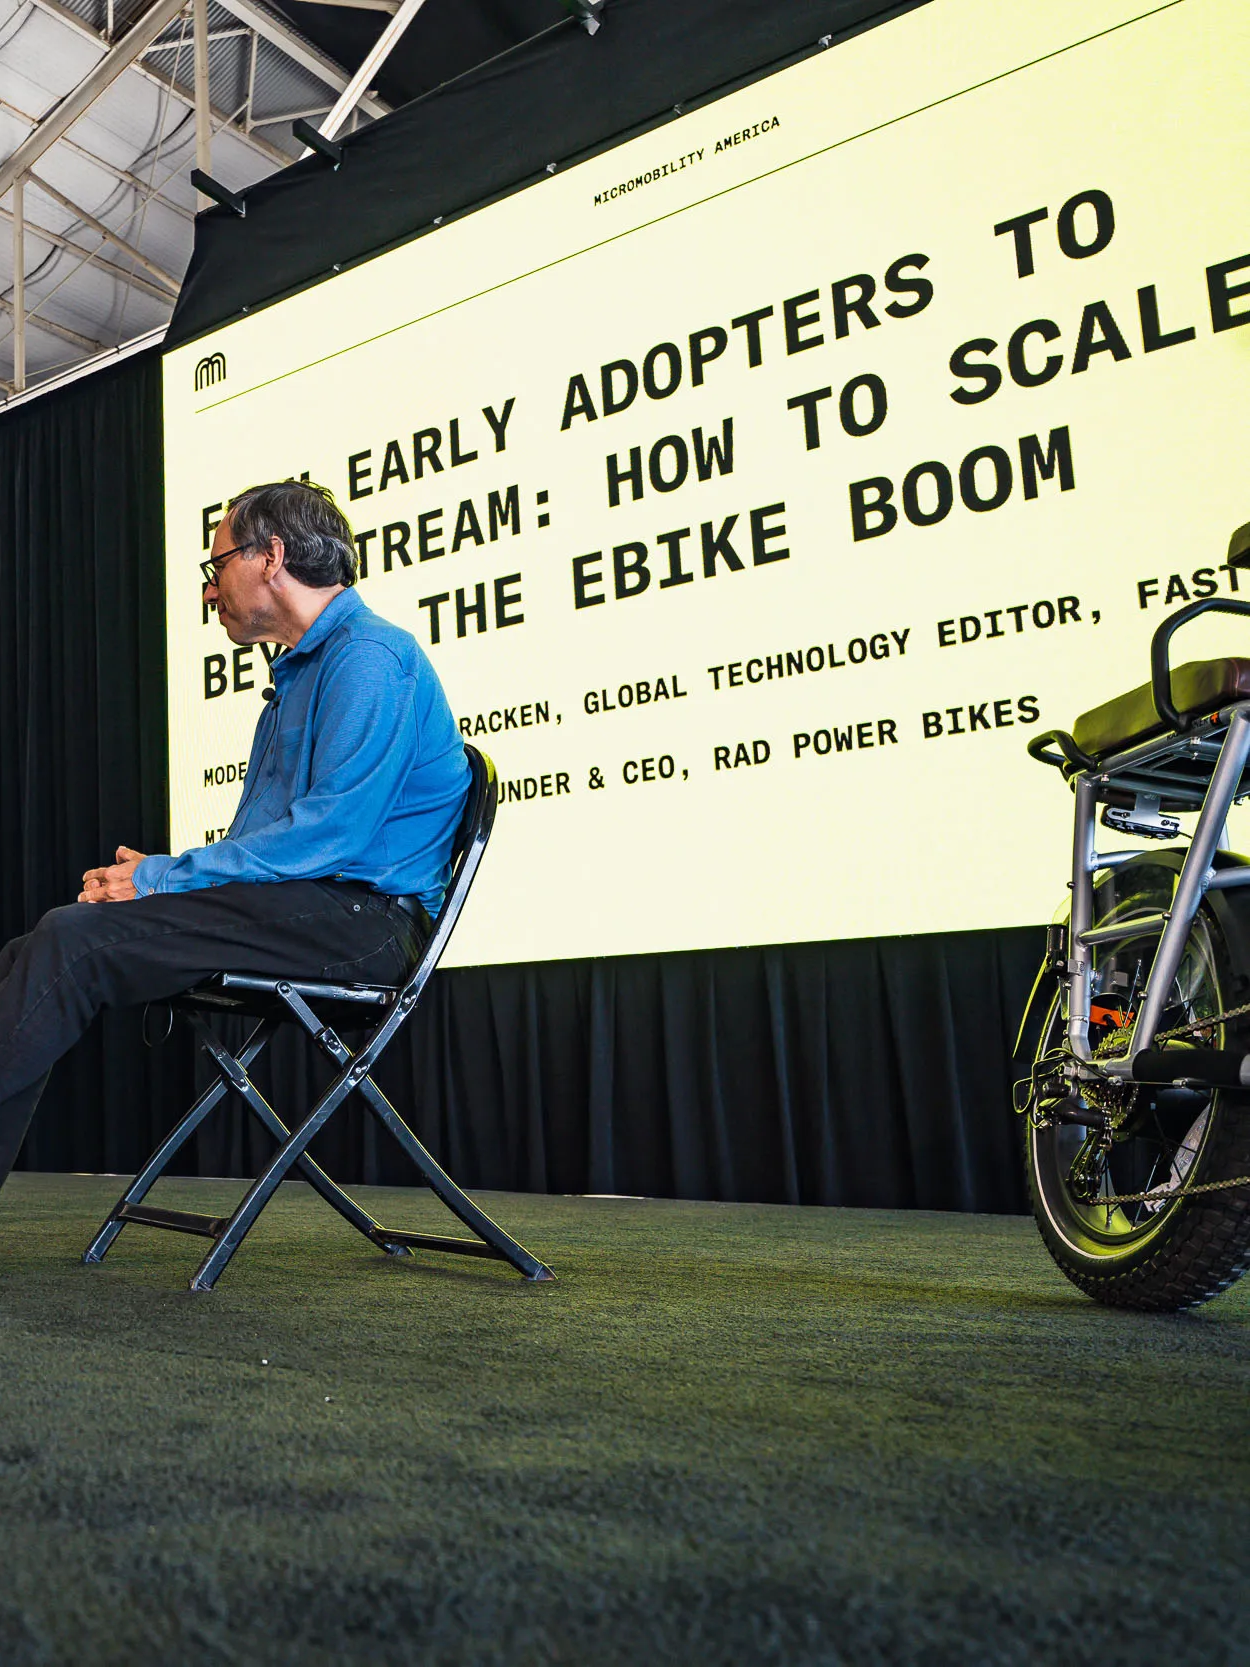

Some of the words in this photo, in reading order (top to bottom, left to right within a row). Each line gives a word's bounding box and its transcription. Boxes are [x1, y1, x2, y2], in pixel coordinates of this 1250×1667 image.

[595, 149, 704, 206] MICROMOBILITY
[715, 117, 779, 153] AMERICA
[349, 398, 515, 501] EARLY
[561, 254, 933, 431] ADOPTERS
[994, 190, 1115, 278] TO
[606, 417, 733, 507] HOW
[787, 374, 887, 450] TO
[949, 254, 1250, 405] SCALE
[204, 642, 284, 700] BEY
[419, 573, 524, 644] THE
[572, 502, 790, 609] EBIKE
[849, 425, 1075, 542] BOOM
[204, 761, 247, 787] MODE
[459, 701, 561, 737] RACKEN,
[584, 675, 687, 714] GLOBAL
[708, 628, 910, 690] TECHNOLOGY
[938, 596, 1100, 647] EDITOR,
[1137, 564, 1238, 609] FAST
[589, 767, 604, 789] &
[623, 755, 688, 784] CEO,
[714, 740, 770, 770] RAD
[794, 719, 898, 758] POWER
[923, 696, 1039, 738] BIKES
